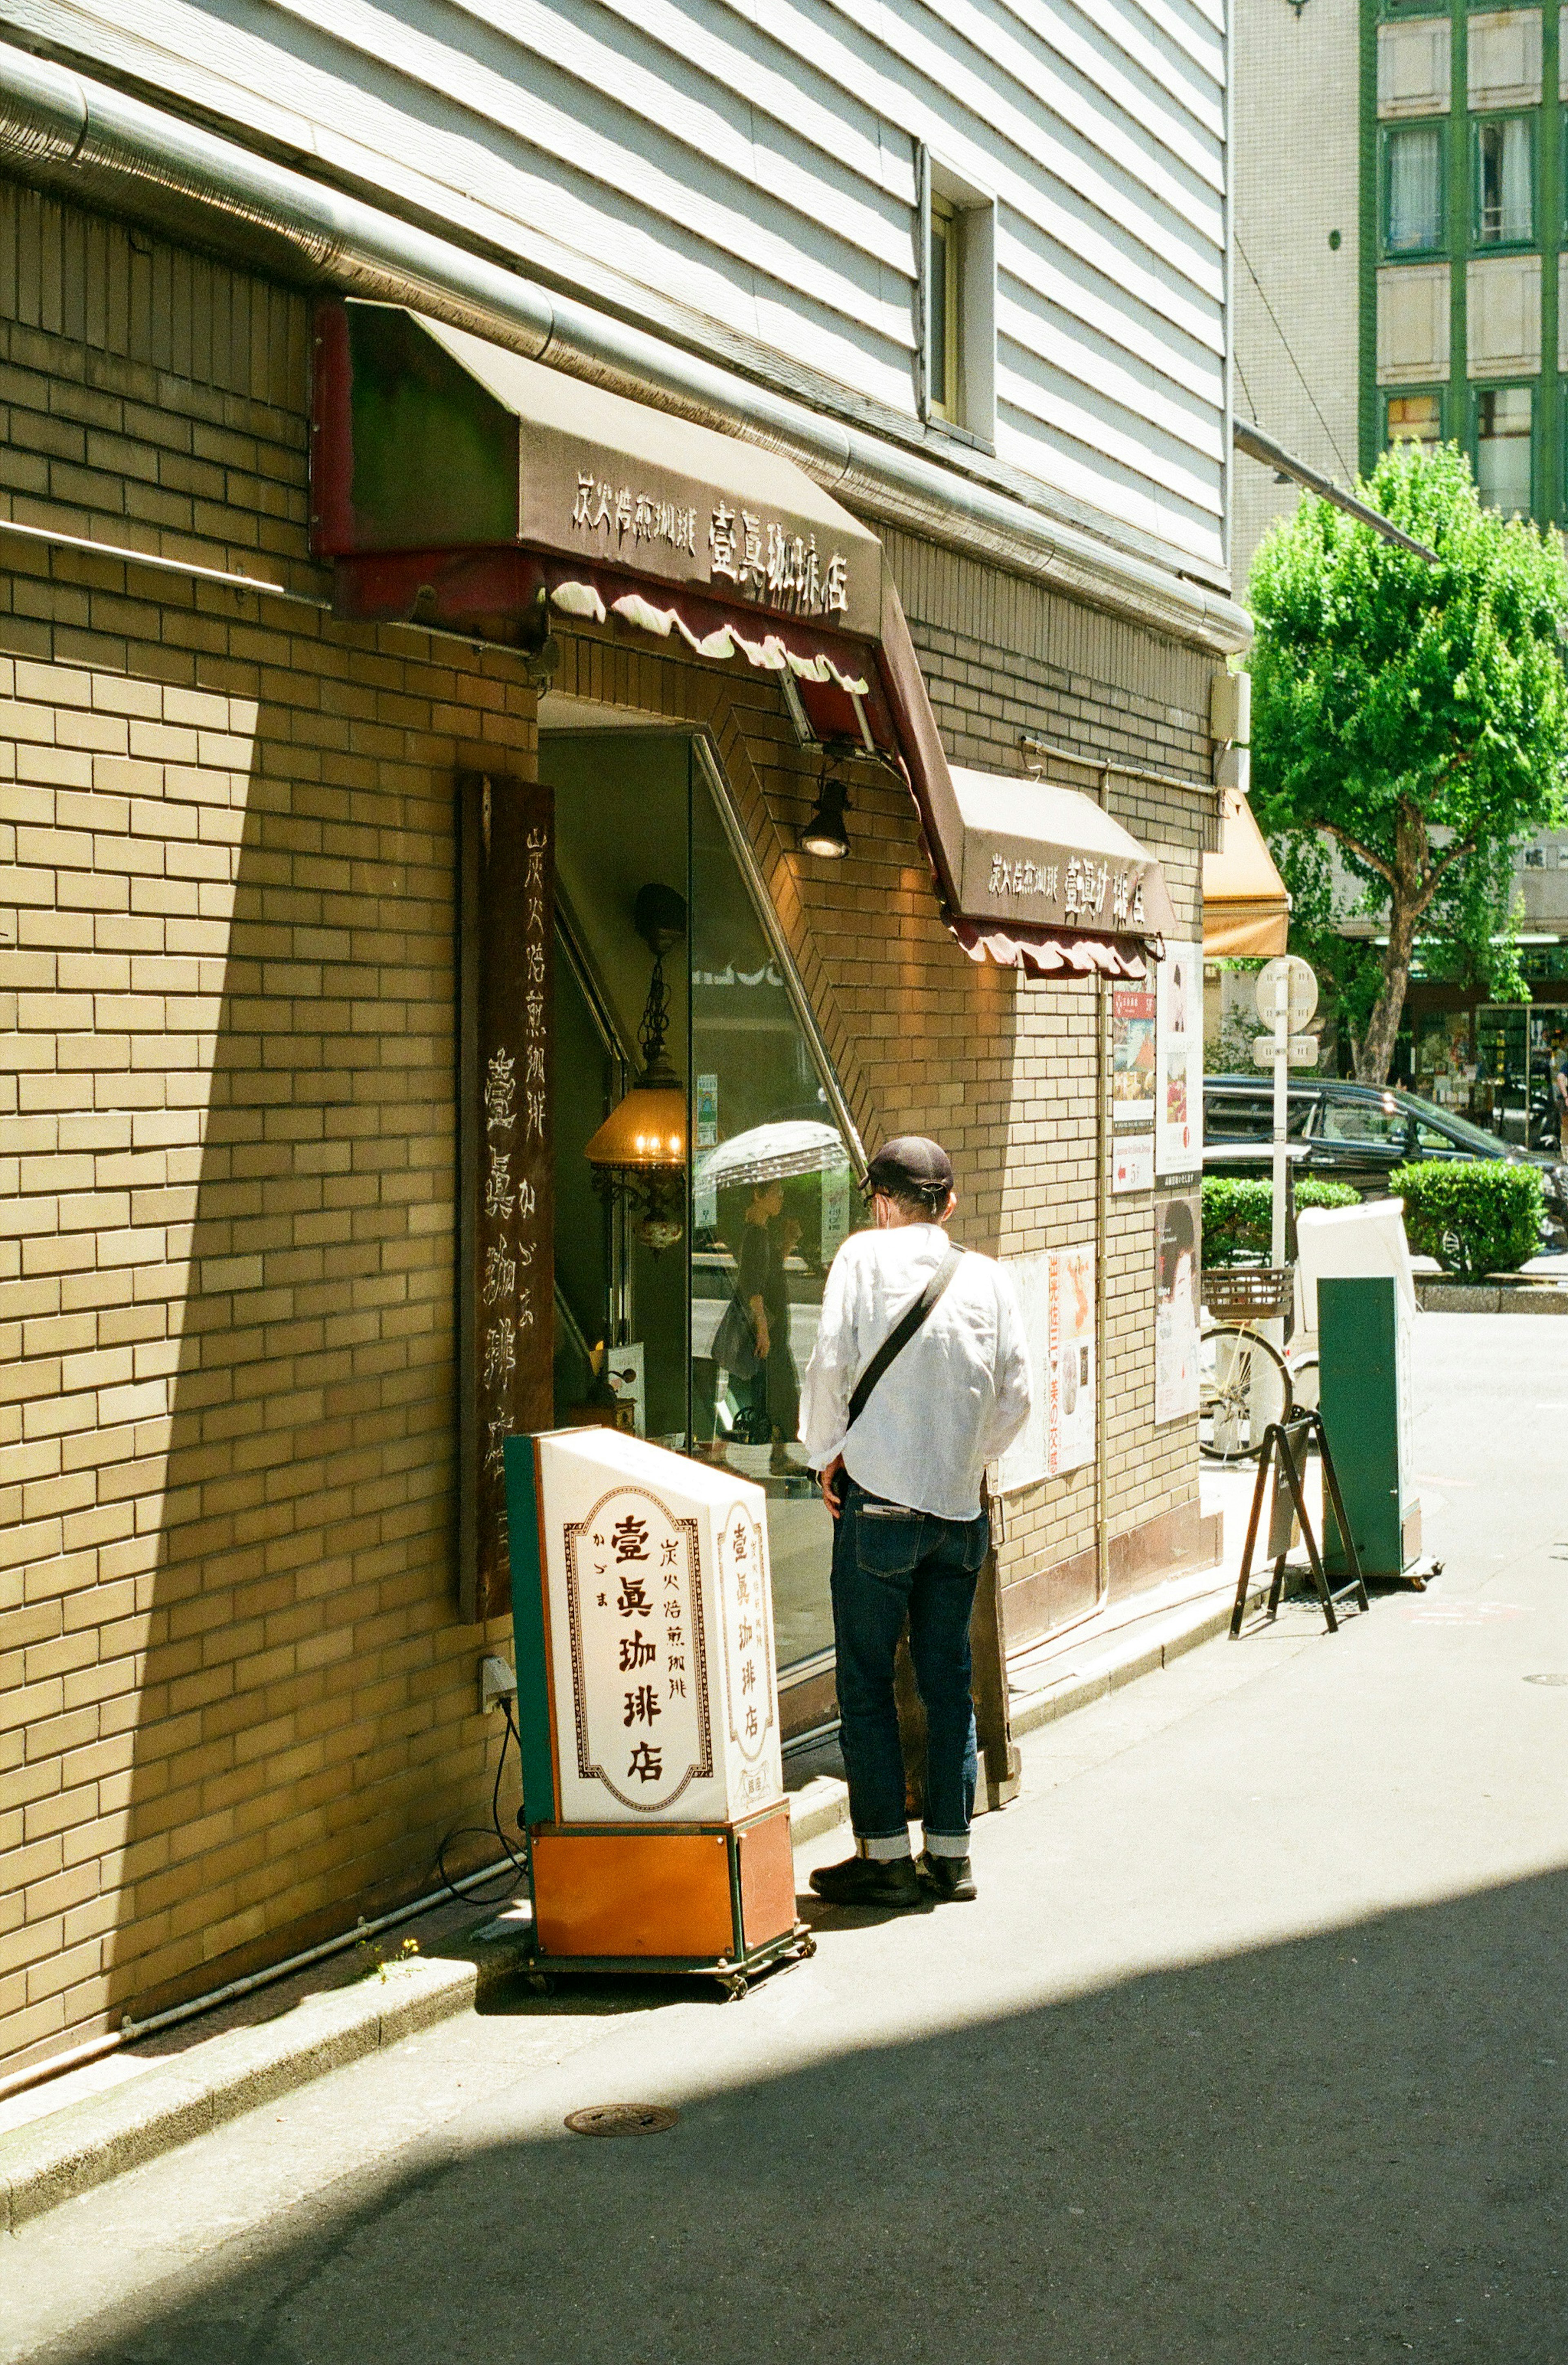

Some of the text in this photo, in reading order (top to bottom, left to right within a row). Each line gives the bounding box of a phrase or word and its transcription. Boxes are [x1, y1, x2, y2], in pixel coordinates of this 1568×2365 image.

[592, 1533, 608, 1608] かづま
[611, 1515, 663, 1784] 壹眞珈琲店
[659, 1538, 687, 1699] 炭火焙煎珈琲
[733, 1523, 758, 1738] 壹眞珈琲店
